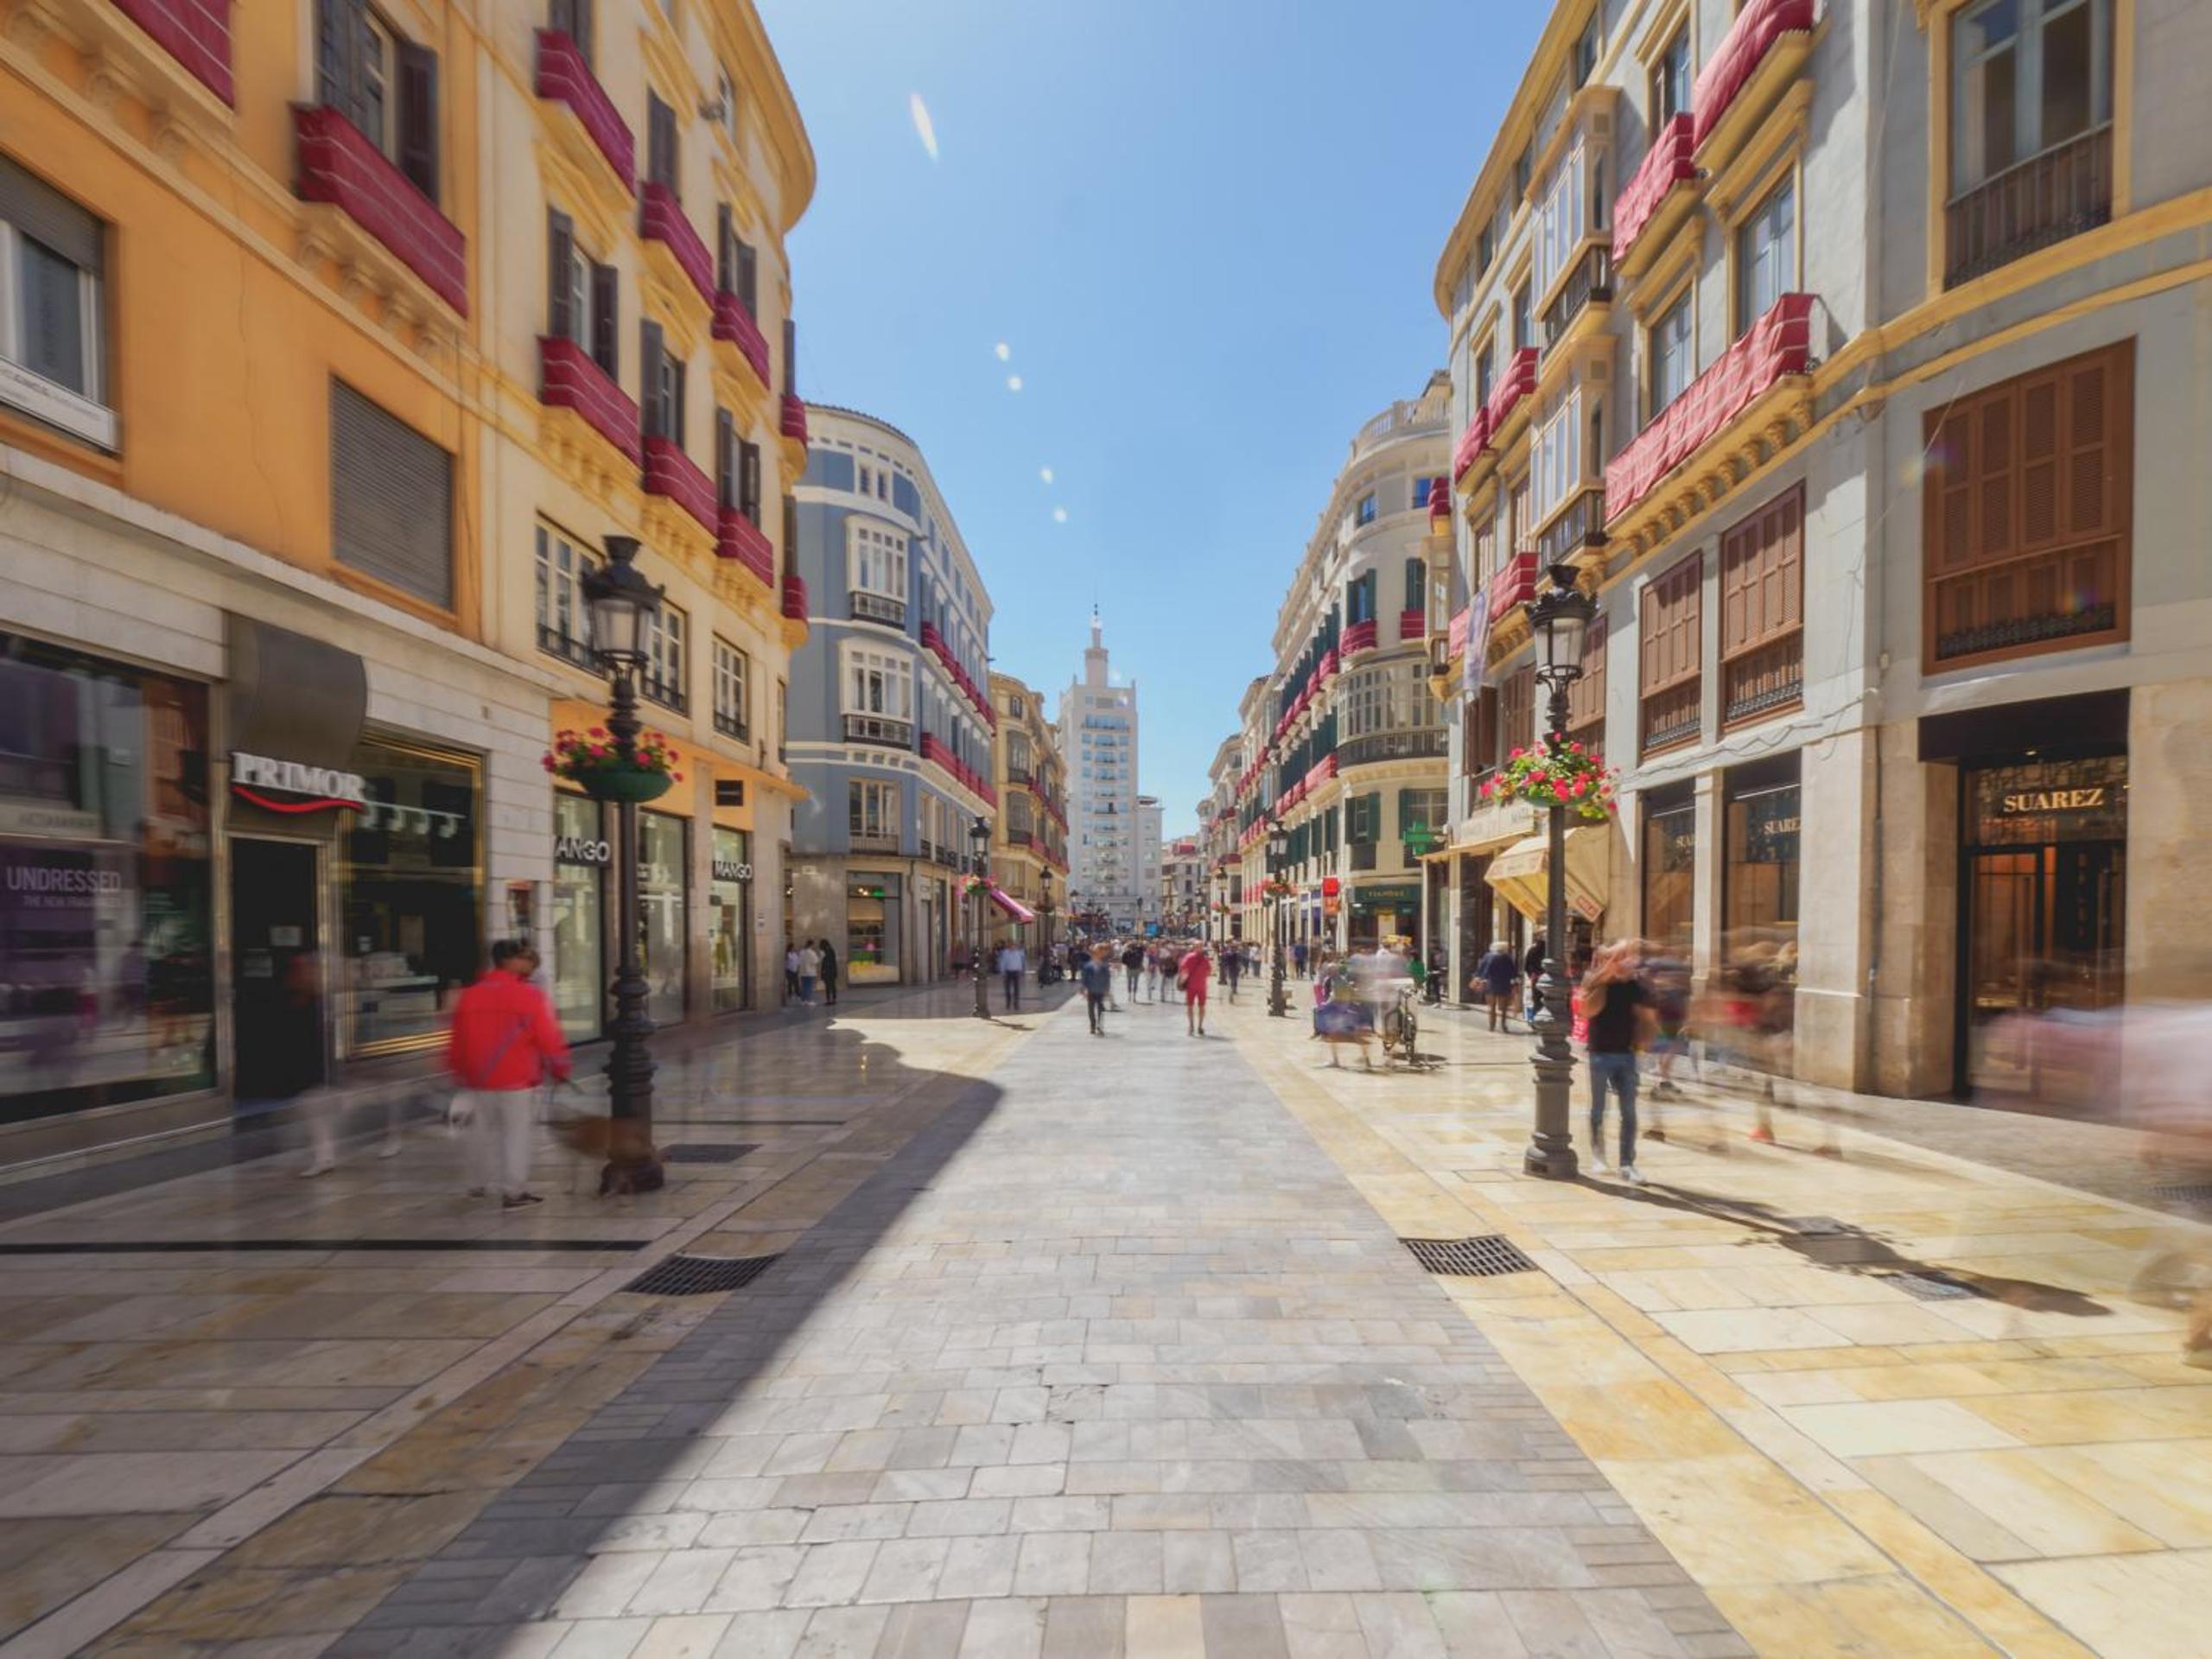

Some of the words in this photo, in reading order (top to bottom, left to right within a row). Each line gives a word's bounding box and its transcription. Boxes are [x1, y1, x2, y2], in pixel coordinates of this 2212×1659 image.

[232, 752, 365, 802] PRIMOR
[2003, 788, 2104, 812] SUAREZ
[1764, 817, 1801, 835] SUARE
[556, 836, 611, 861] ANGO
[7, 867, 121, 893] UNDRESSED
[715, 861, 753, 879] MANGO
